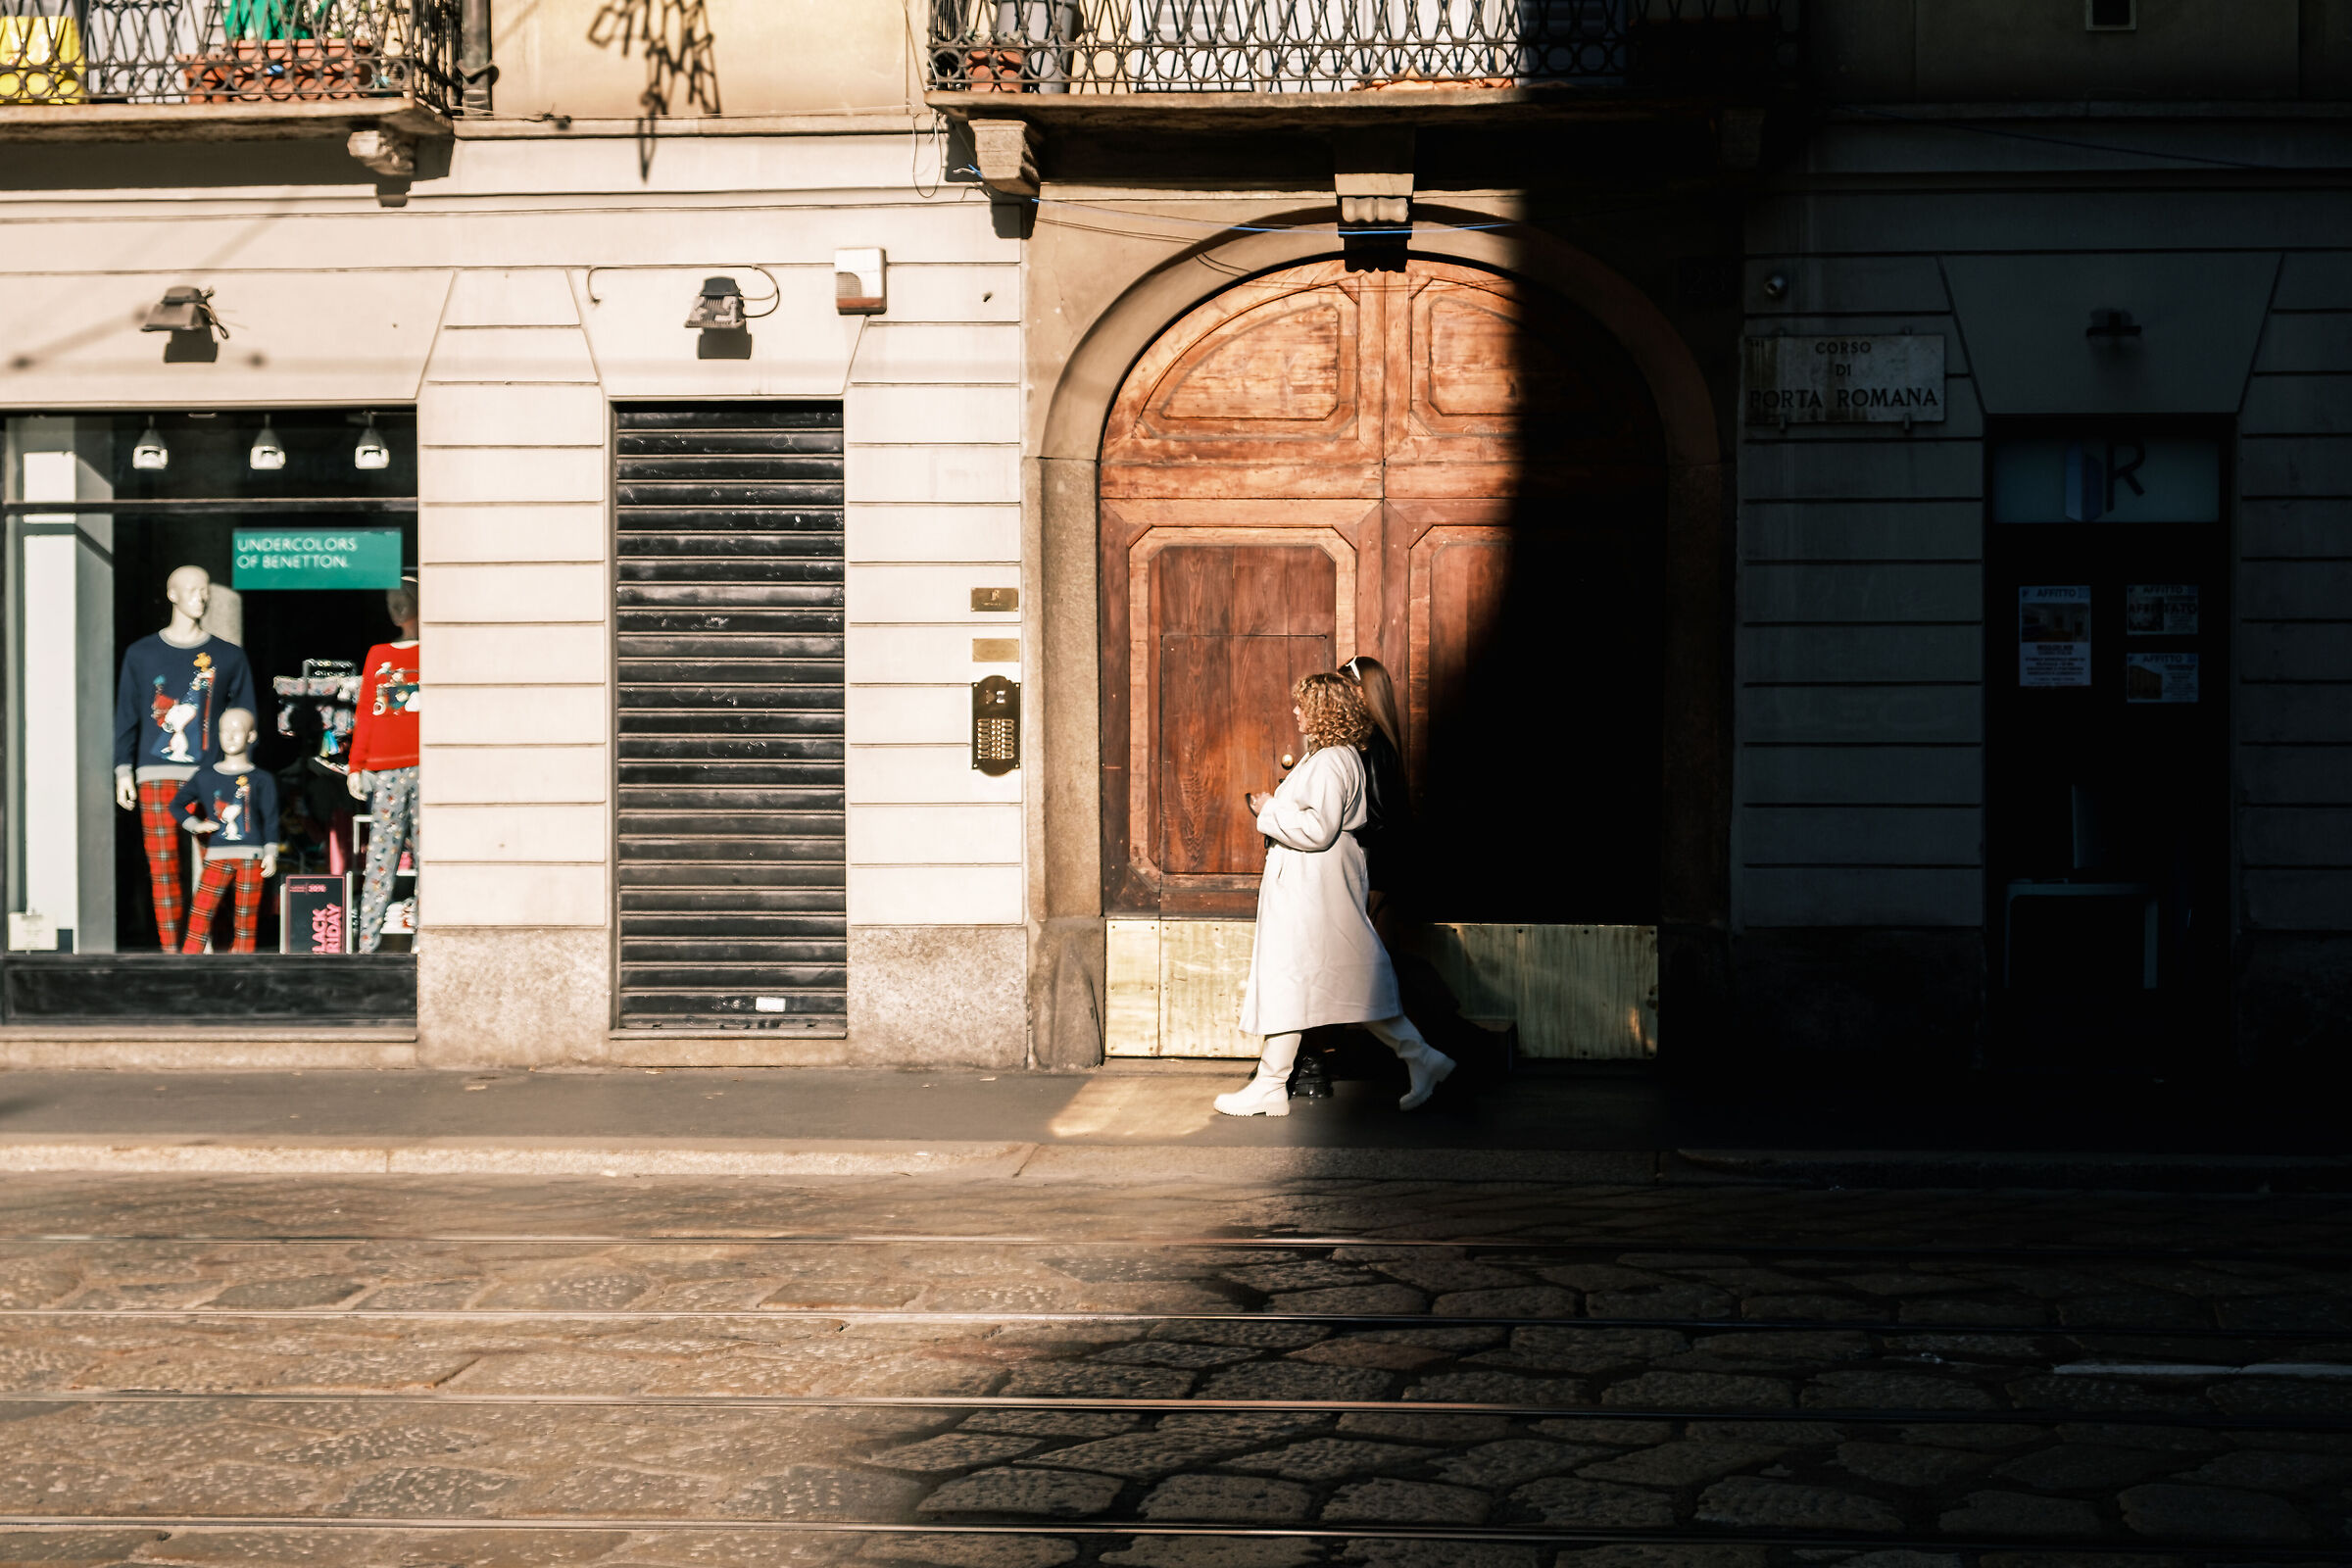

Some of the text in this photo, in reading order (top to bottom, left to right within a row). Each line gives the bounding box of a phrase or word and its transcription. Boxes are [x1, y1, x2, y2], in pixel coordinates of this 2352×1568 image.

[1815, 341, 1872, 354] CORSO
[1836, 364, 1851, 376] DI
[1749, 388, 1938, 409] PORTA ROMANA
[236, 537, 359, 552] UNDERCOLORS
[236, 555, 259, 569] OF
[2036, 587, 2077, 597] AFFITTO
[312, 908, 327, 955] LACK
[326, 902, 342, 954] RIDAY
